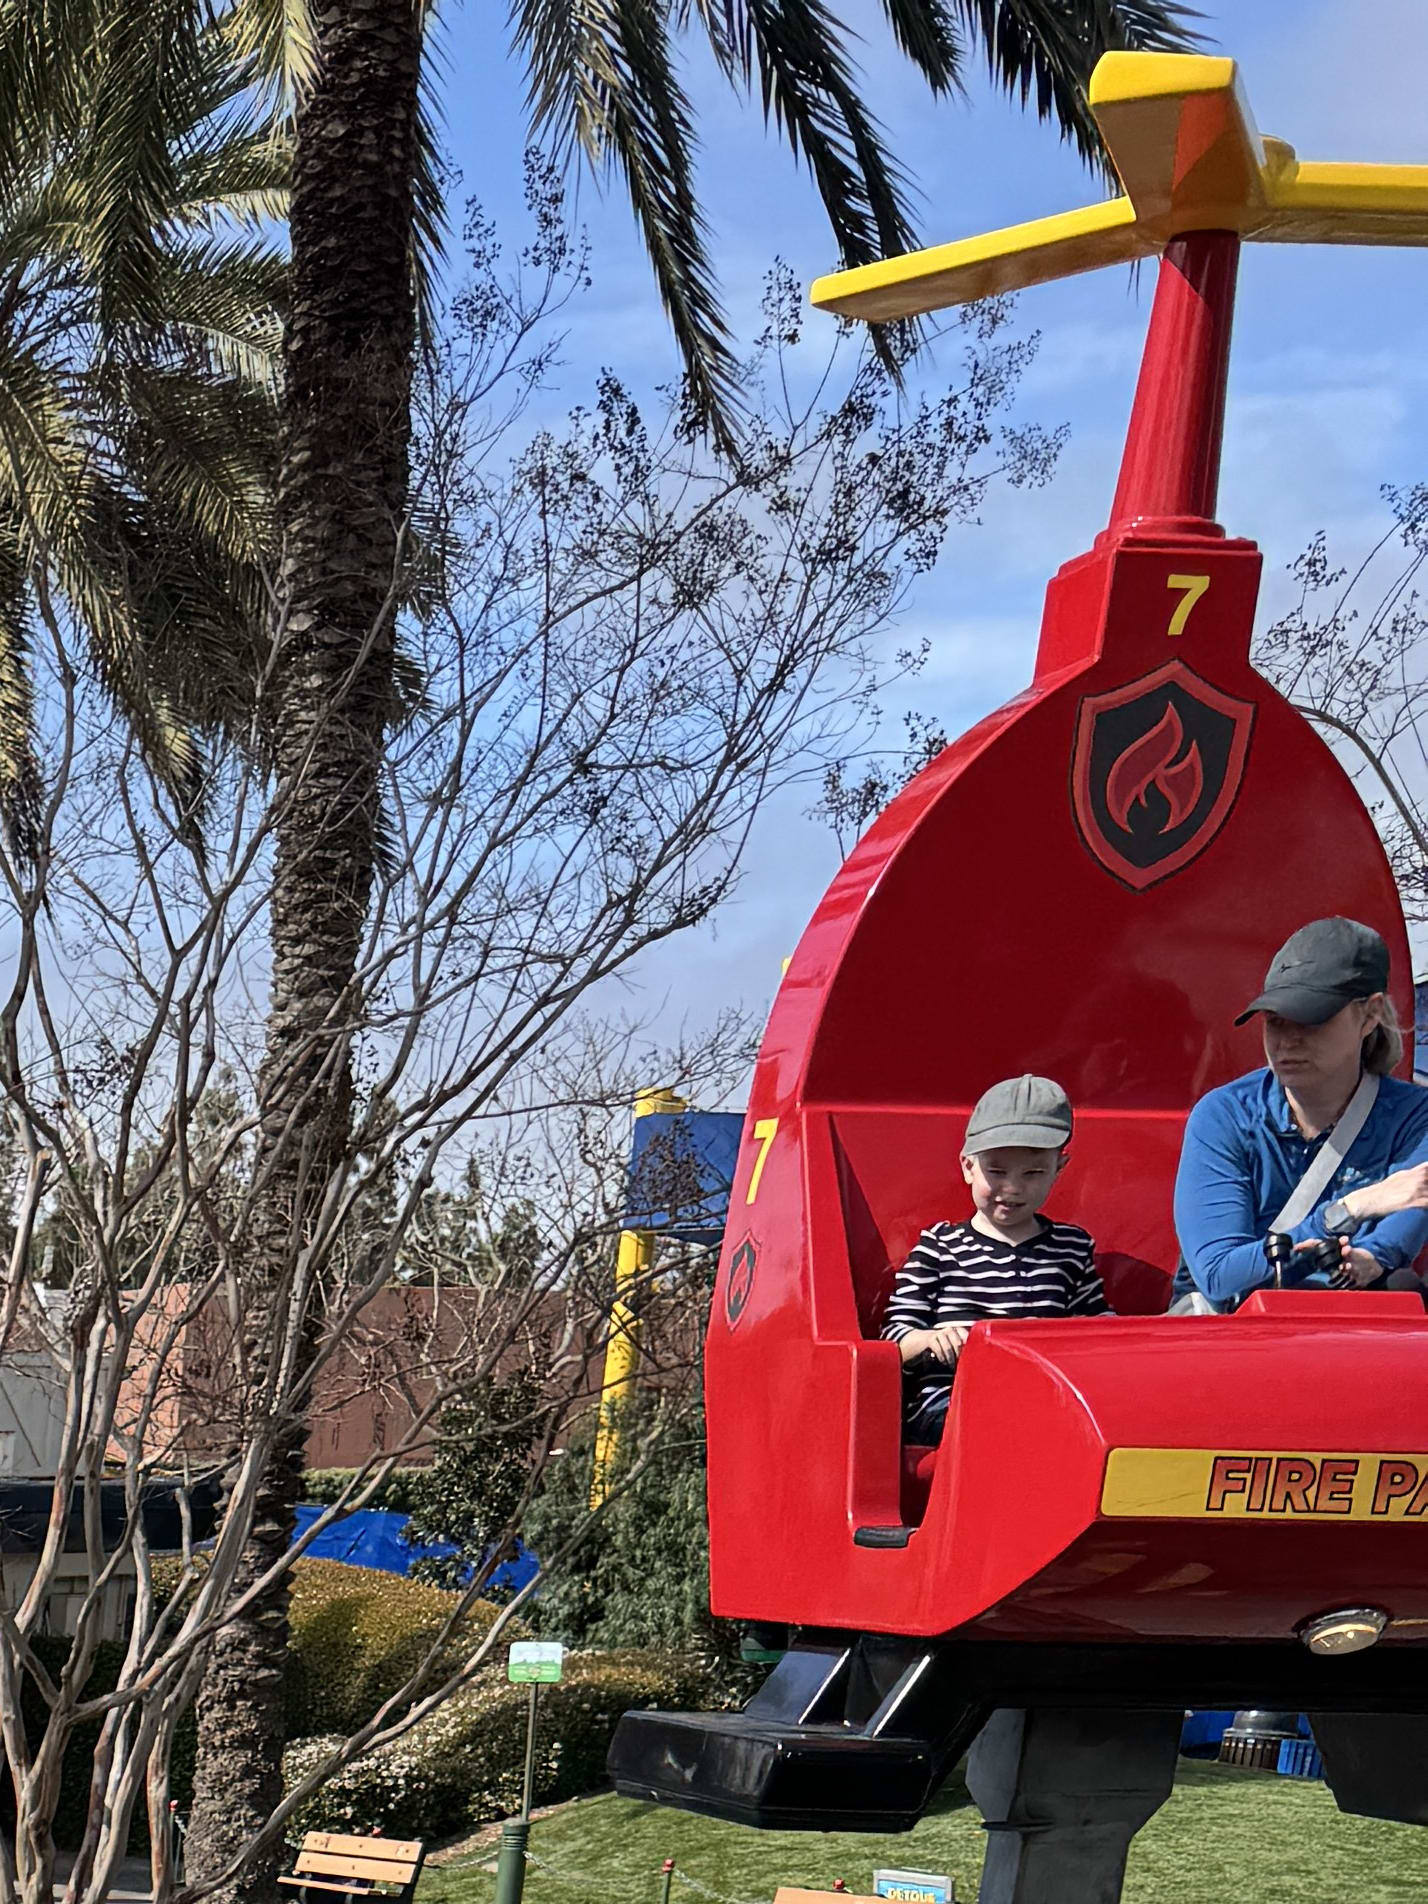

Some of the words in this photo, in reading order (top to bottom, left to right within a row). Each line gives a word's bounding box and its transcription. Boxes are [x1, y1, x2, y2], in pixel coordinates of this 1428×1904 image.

[1166, 573, 1211, 636] 7
[746, 1118, 779, 1206] 7
[1206, 1456, 1360, 1514] FIRE
